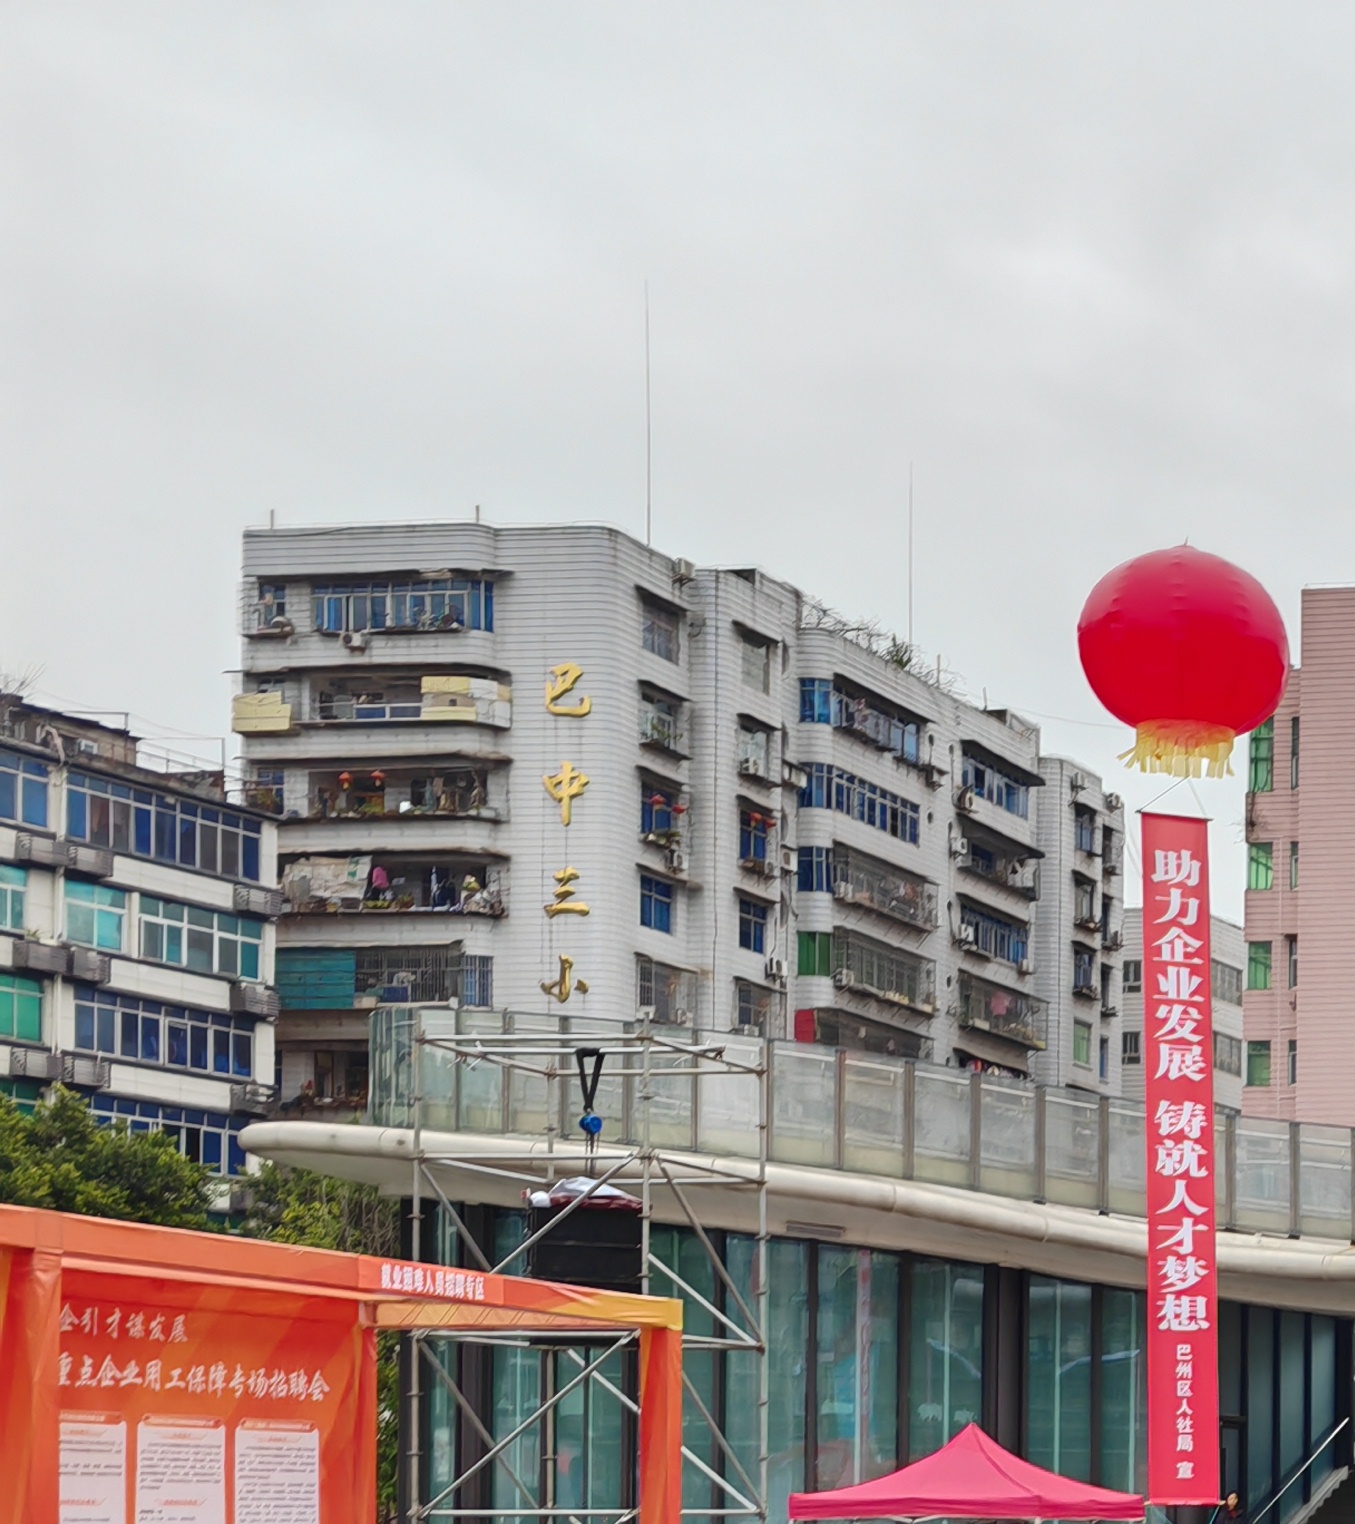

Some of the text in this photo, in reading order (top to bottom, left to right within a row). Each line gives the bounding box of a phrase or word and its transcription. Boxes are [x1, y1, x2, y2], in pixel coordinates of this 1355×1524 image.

[541, 661, 592, 1003] 巴中三小
[1151, 848, 1211, 1332] 助力企业发展 铸就人才梦想
[1175, 1343, 1195, 1480] 巴州区人社局 宣
